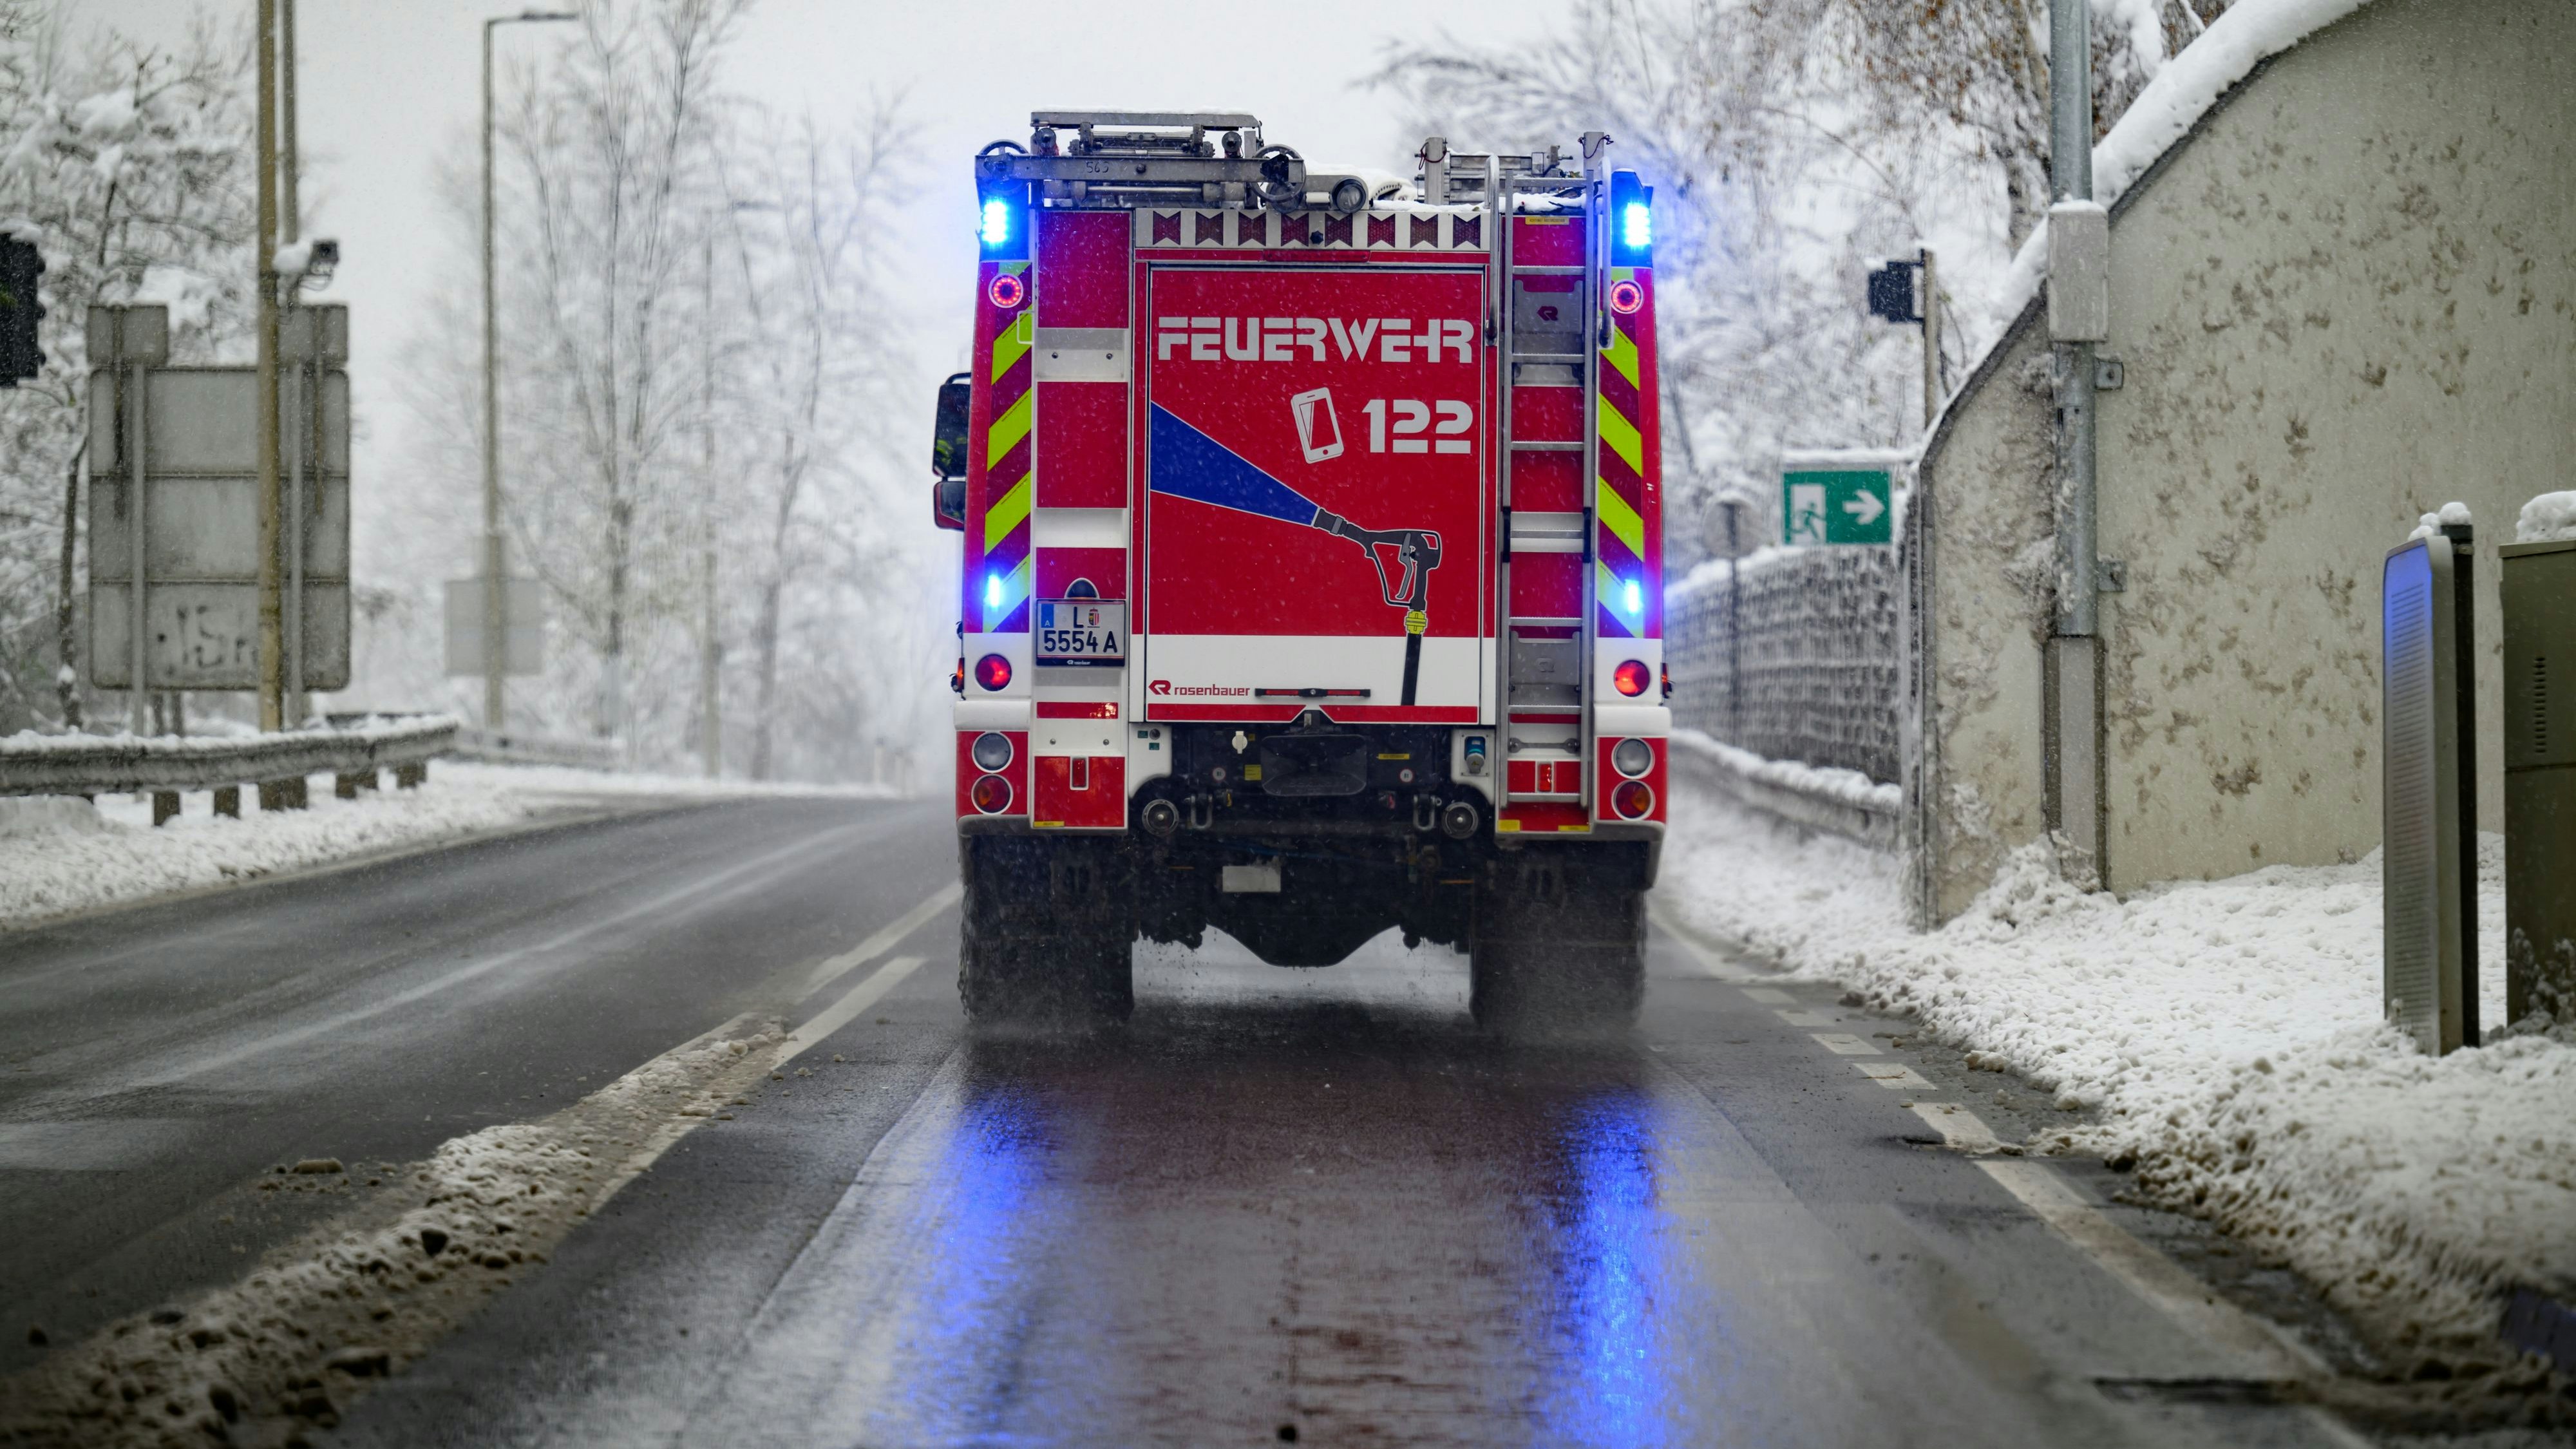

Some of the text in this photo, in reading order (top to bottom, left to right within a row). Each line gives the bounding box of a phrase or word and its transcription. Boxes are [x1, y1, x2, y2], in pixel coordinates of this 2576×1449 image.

[1159, 317, 1474, 363] FEUERWEHR
[1362, 399, 1473, 453] 122
[1074, 606, 1084, 628] L
[1044, 630, 1117, 652] 5554 A
[1174, 684, 1250, 696] rosenbauer
